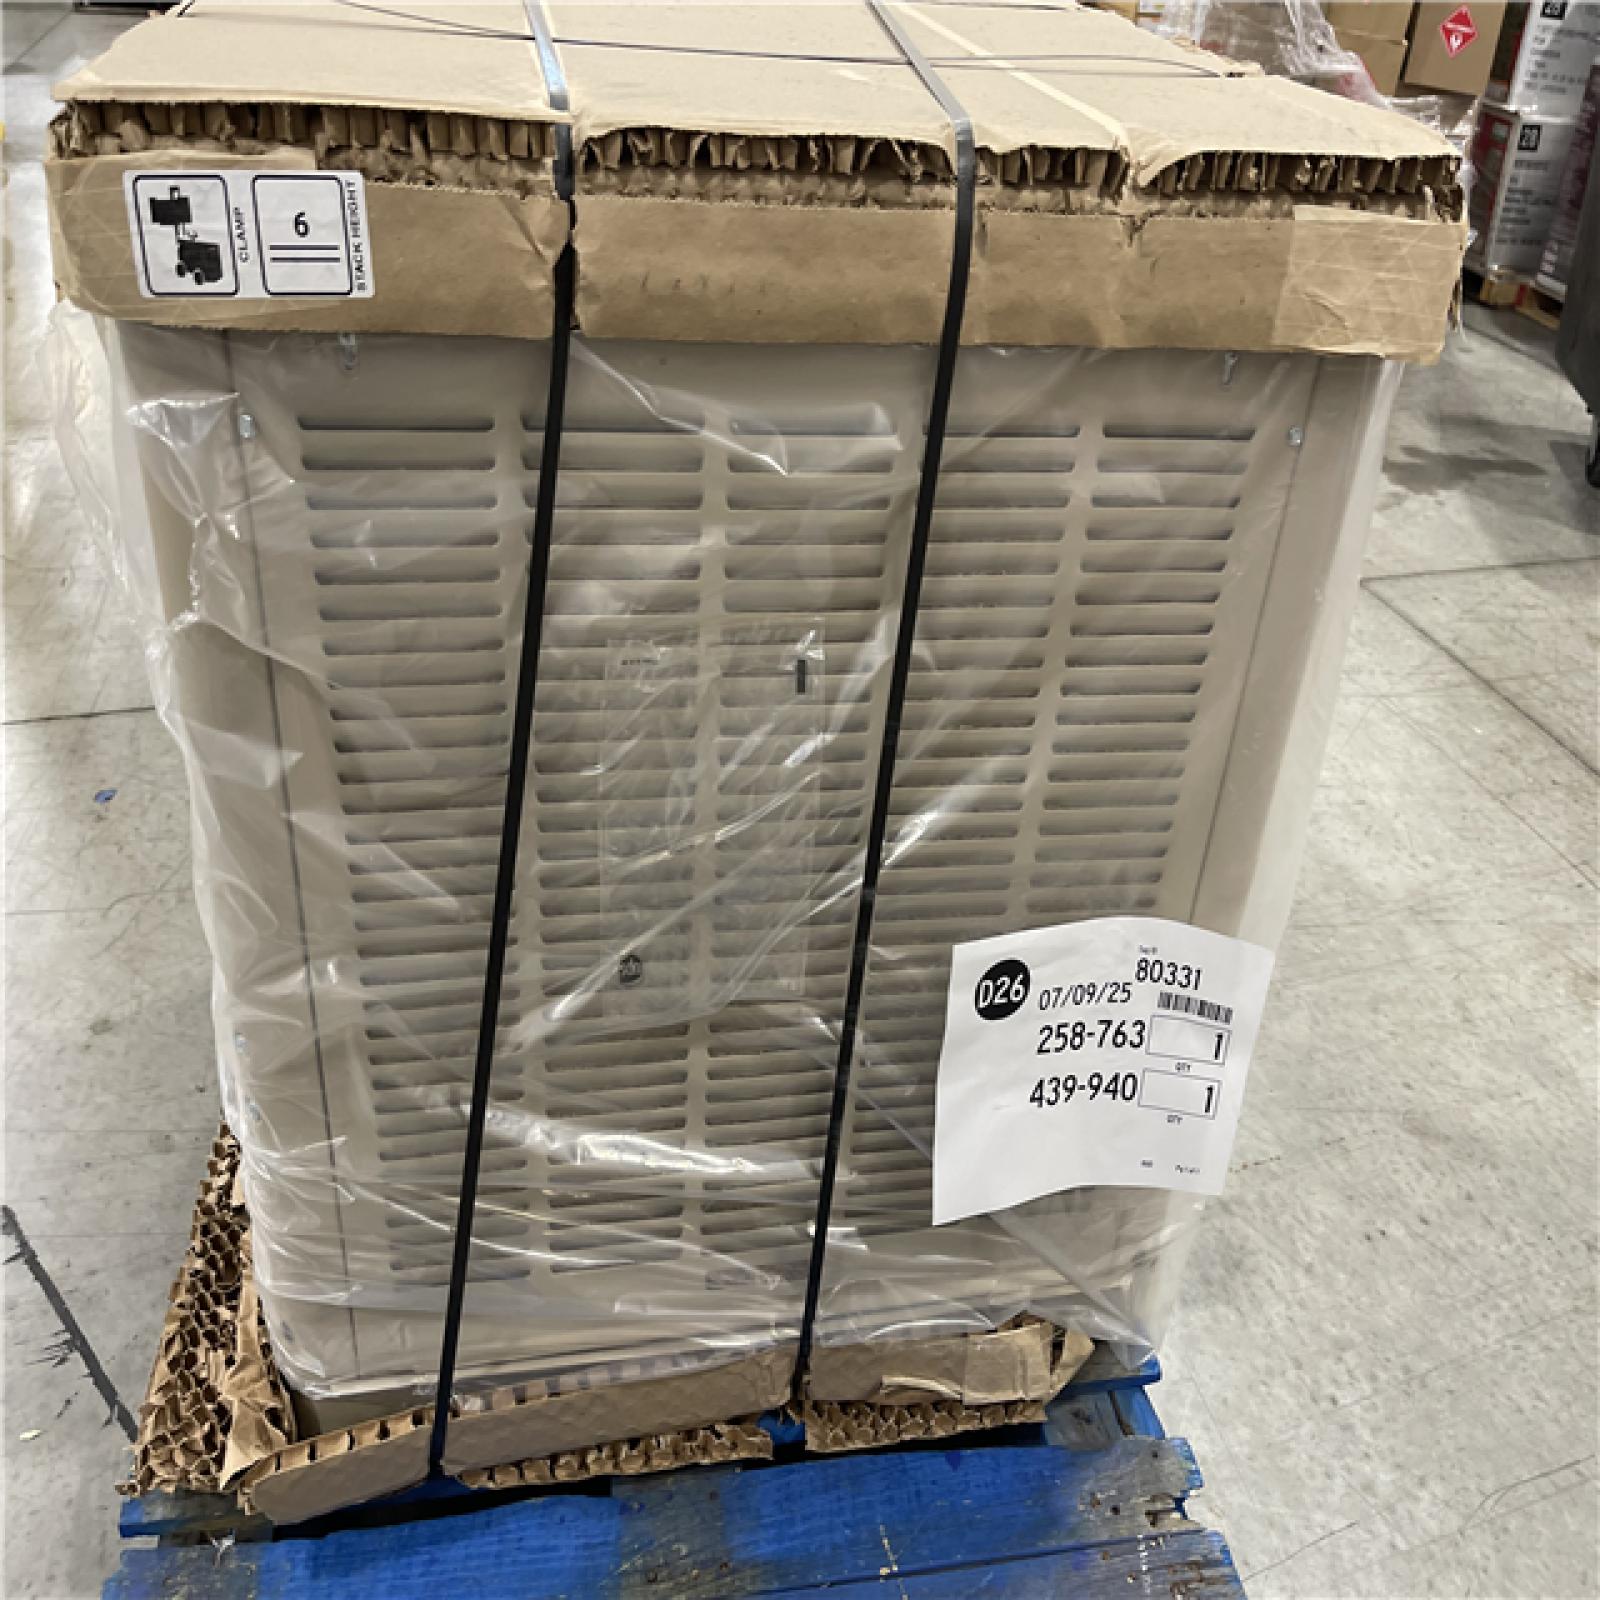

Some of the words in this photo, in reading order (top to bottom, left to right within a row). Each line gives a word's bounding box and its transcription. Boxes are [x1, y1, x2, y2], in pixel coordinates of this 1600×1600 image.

[294, 212, 309, 237] 6
[345, 180, 361, 238] HEIGHT
[233, 207, 249, 263] CLAMP
[351, 242, 366, 291] STACK
[978, 974, 1025, 1008] D26
[1135, 957, 1202, 991] 80331
[1039, 982, 1132, 1011] 07/09/25
[1036, 1019, 1146, 1055] 258-763
[1214, 1032, 1224, 1060] 1
[1029, 1072, 1138, 1108] 439-940
[1204, 1085, 1214, 1113] 1
